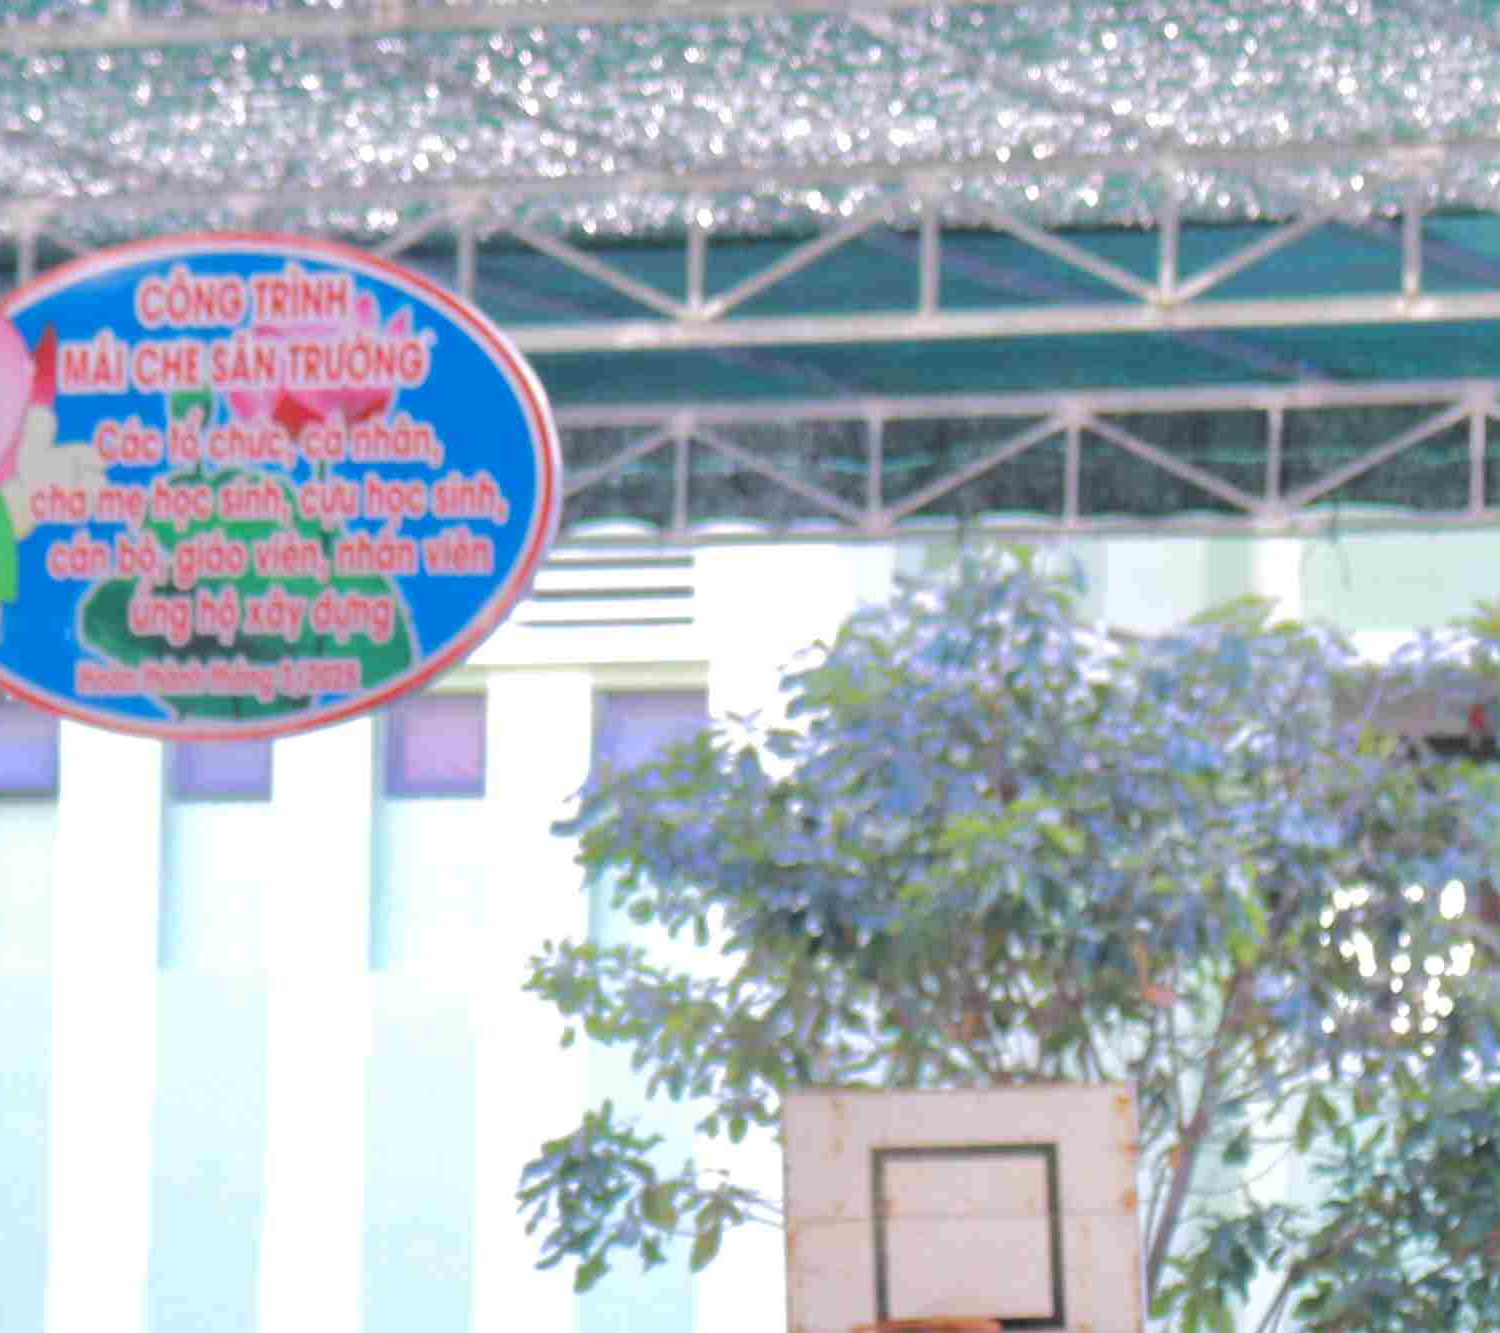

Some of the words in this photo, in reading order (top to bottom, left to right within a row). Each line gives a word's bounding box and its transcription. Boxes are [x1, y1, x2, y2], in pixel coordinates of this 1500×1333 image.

[138, 265, 243, 323] CÔNG
[252, 263, 348, 320] TRÌNH
[133, 345, 200, 386] CHE
[210, 332, 276, 384] SÂN
[97, 417, 161, 460] Các
[30, 483, 87, 519] cha
[152, 477, 212, 532] học
[365, 473, 426, 528] học
[433, 471, 508, 524] sinh,
[336, 530, 419, 574] nhân
